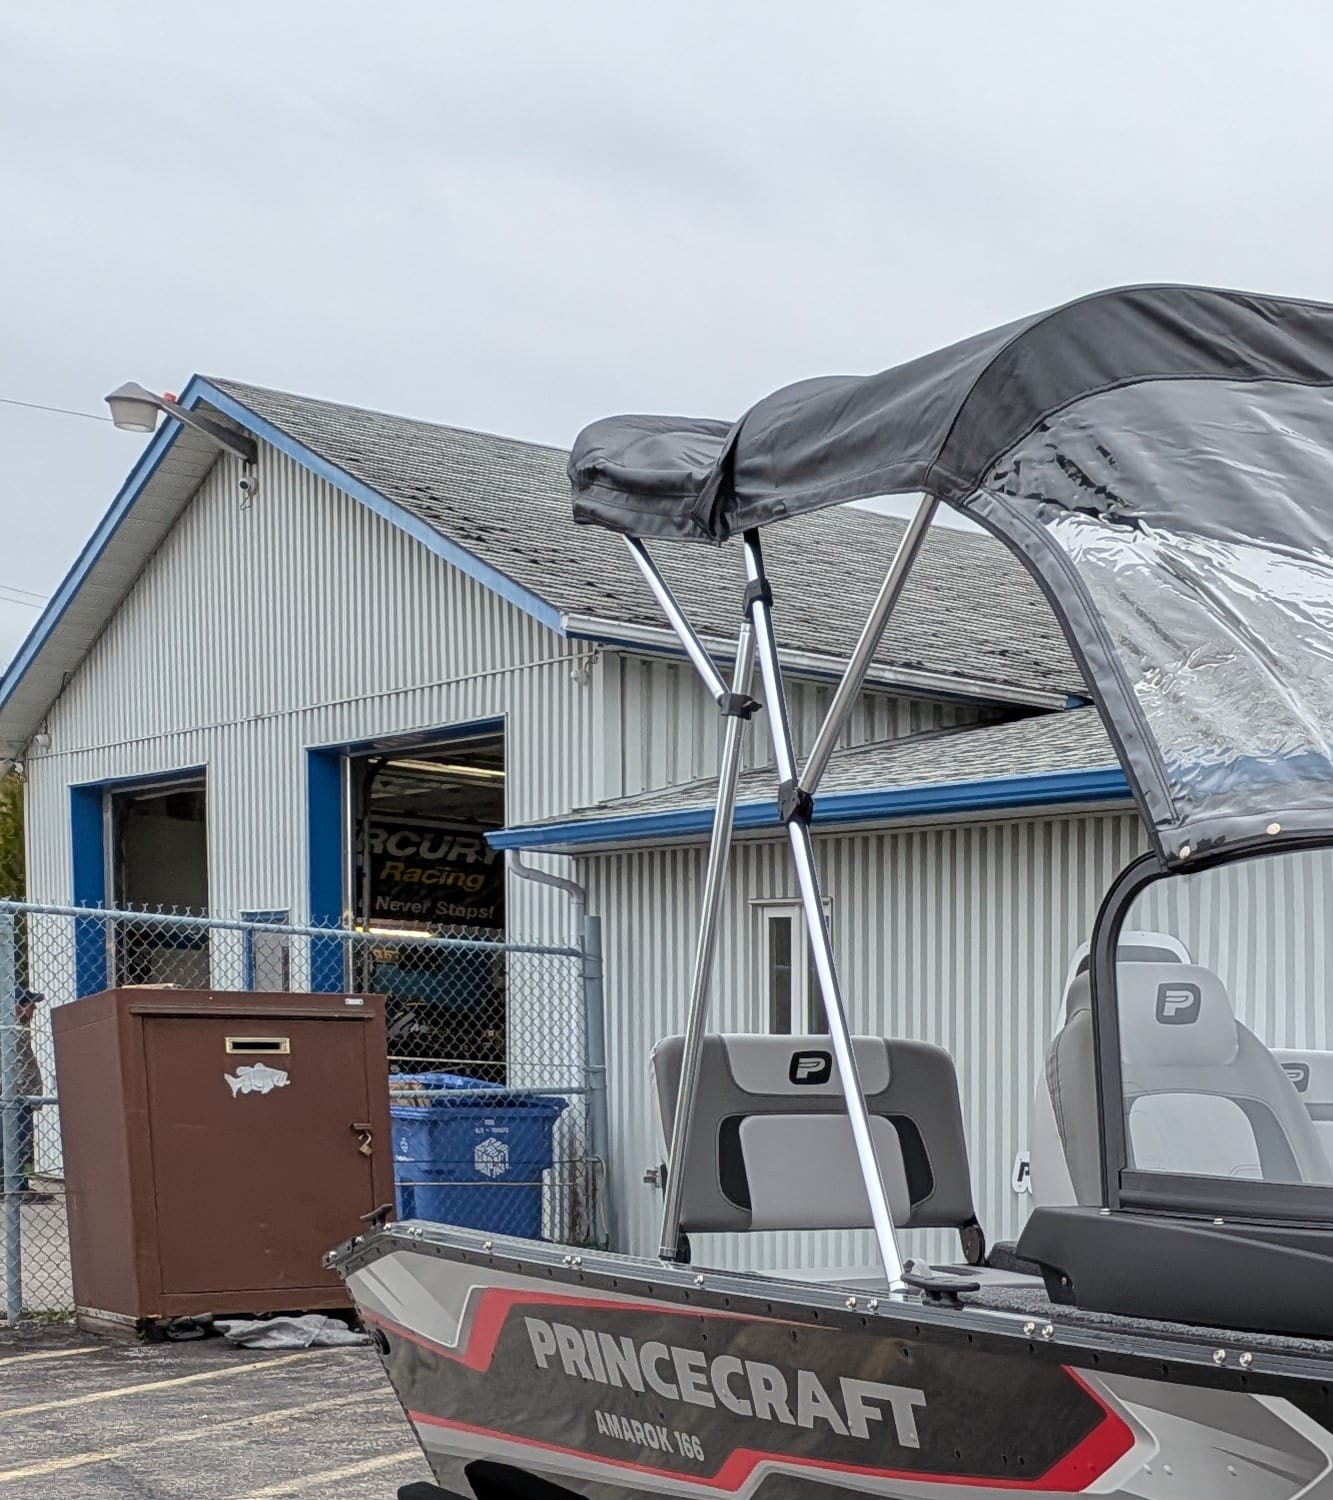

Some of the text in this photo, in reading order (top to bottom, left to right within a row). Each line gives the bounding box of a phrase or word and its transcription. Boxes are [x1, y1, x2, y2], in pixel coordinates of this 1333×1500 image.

[379, 861, 486, 893] Racing
[375, 896, 495, 920] Never Stops!
[524, 1316, 927, 1449] PRINCECRAFT
[595, 1410, 705, 1461] AMAROK 166
